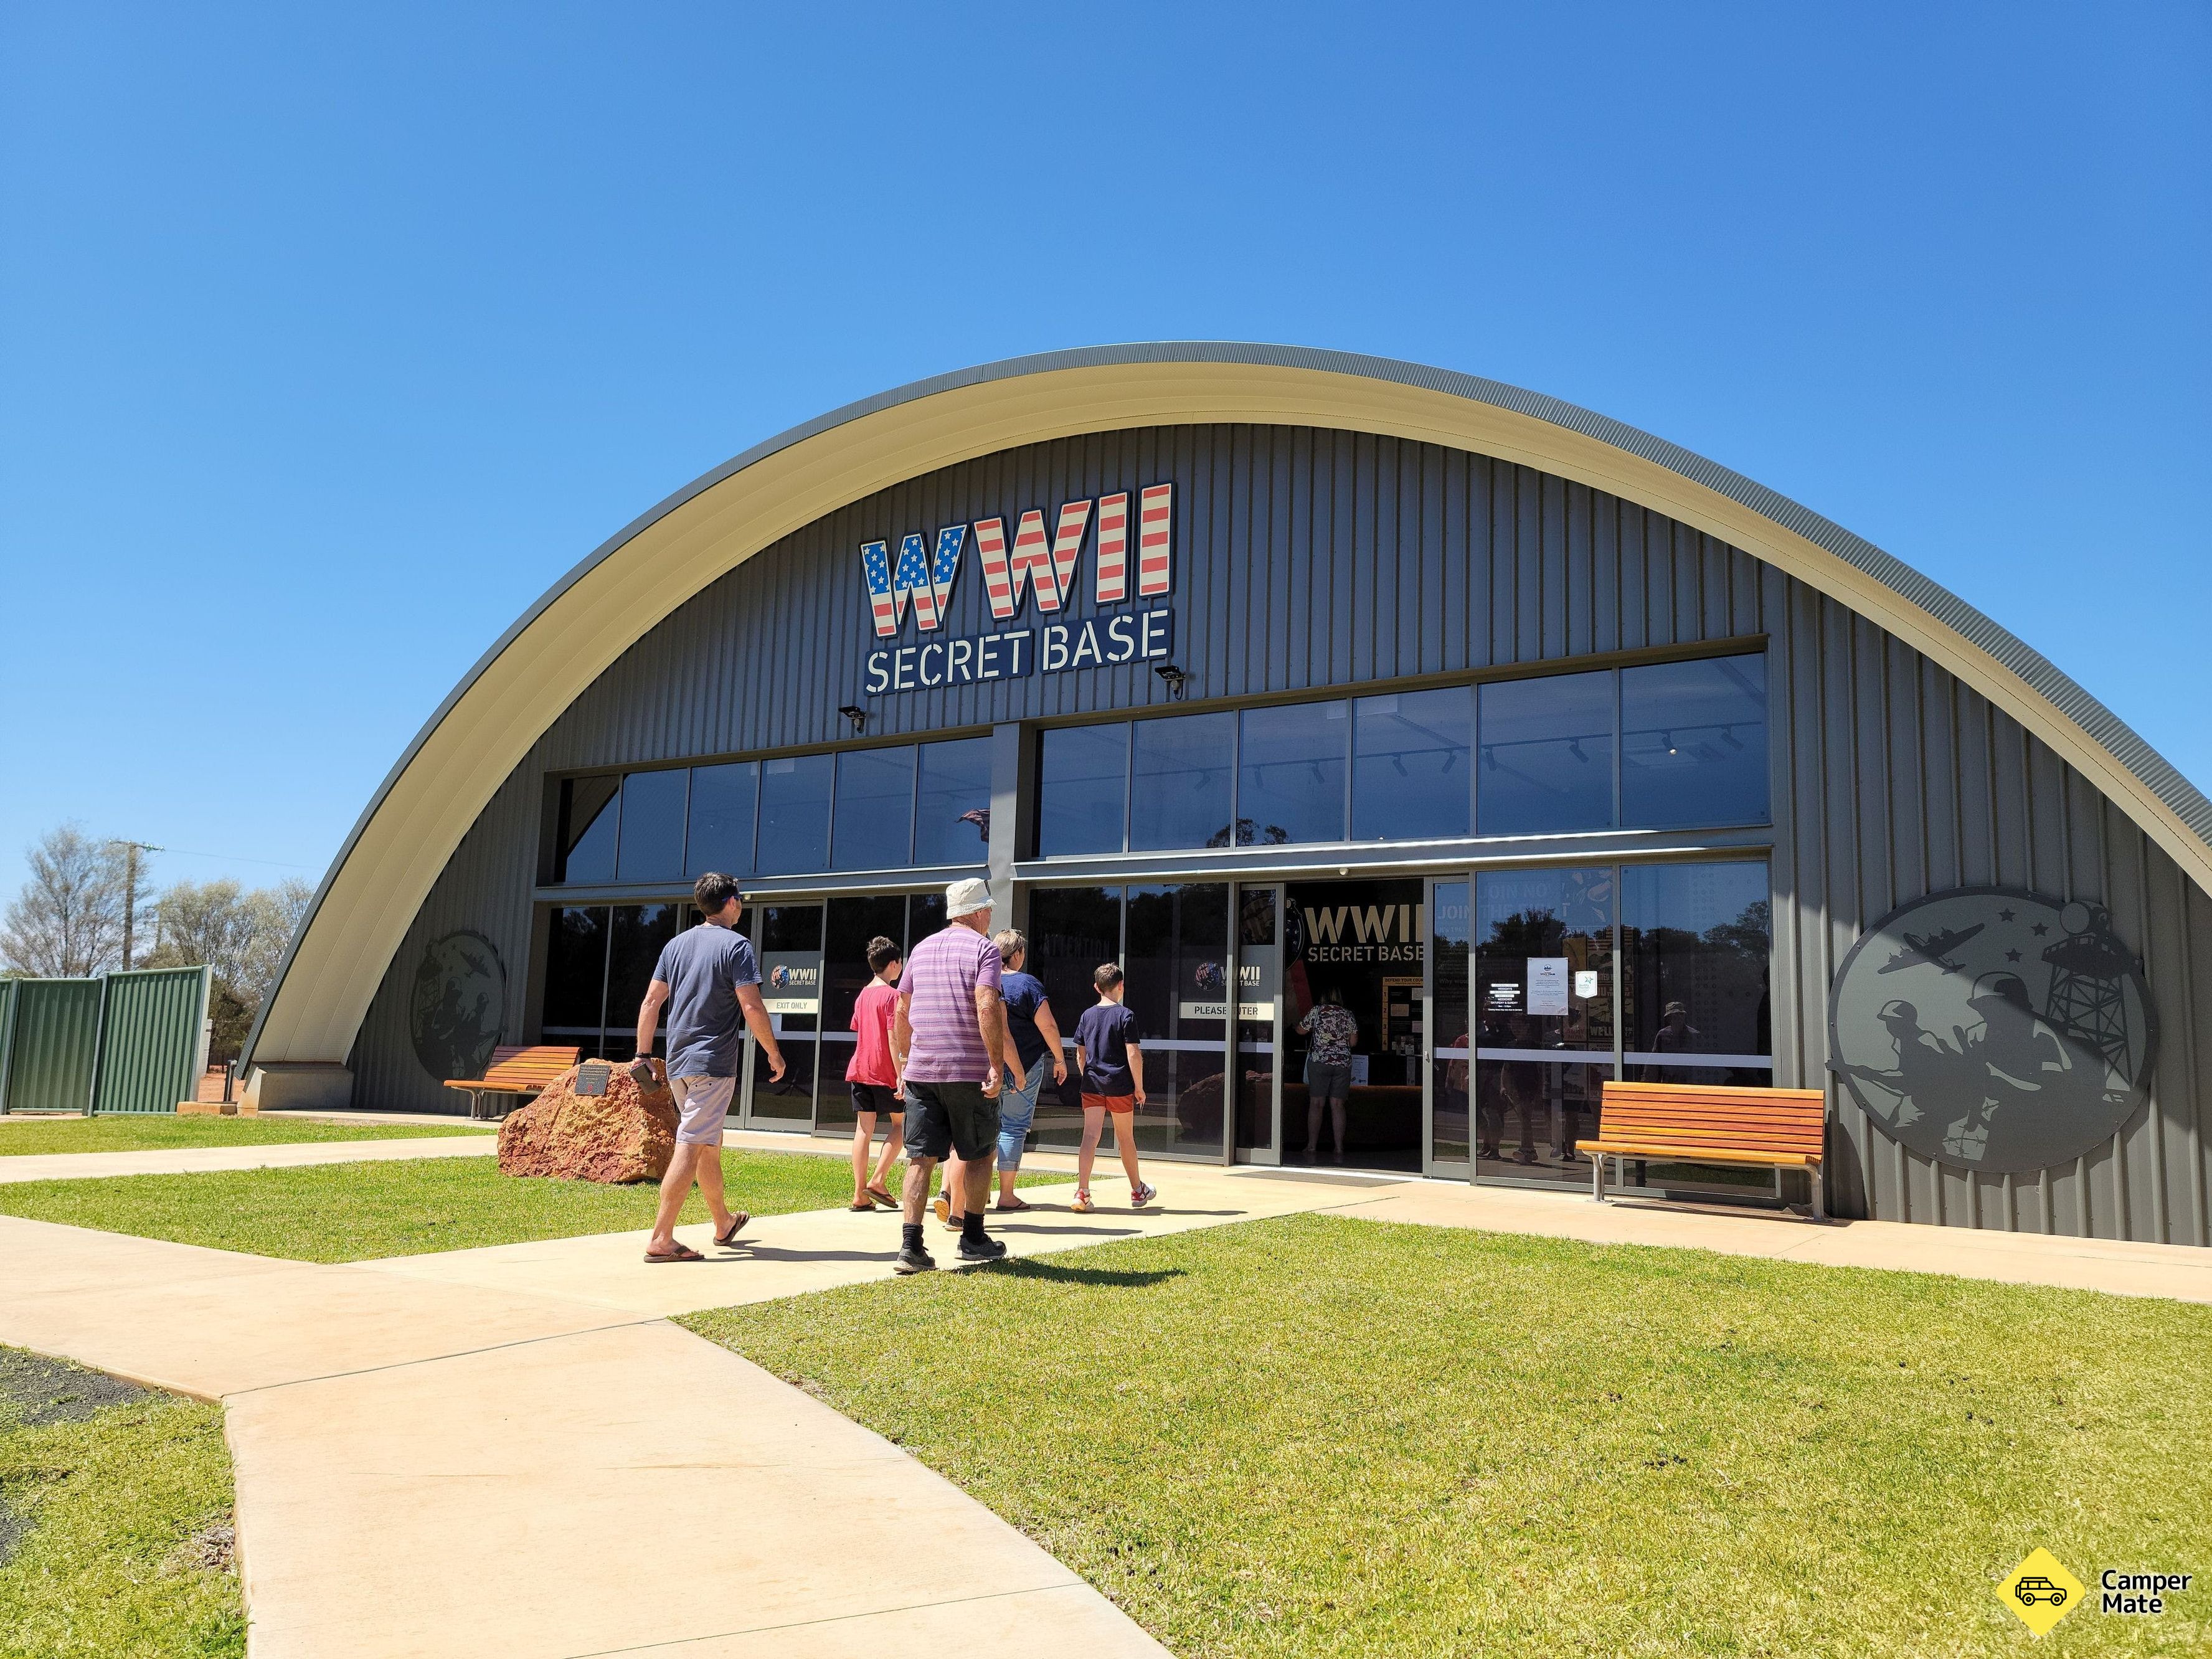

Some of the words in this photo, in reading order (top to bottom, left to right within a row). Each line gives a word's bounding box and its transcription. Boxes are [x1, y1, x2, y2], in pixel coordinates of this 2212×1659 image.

[860, 483, 1172, 637] WWII
[866, 630, 1031, 692] SECRET
[1042, 609, 1168, 671] BASE
[1304, 904, 1424, 943] WWII
[1308, 946, 1374, 962] SECRET
[1378, 945, 1424, 962] BASE
[788, 968, 817, 980] WWII
[1194, 1006, 1227, 1014] PLEASE
[1239, 1007, 1258, 1015] TER
